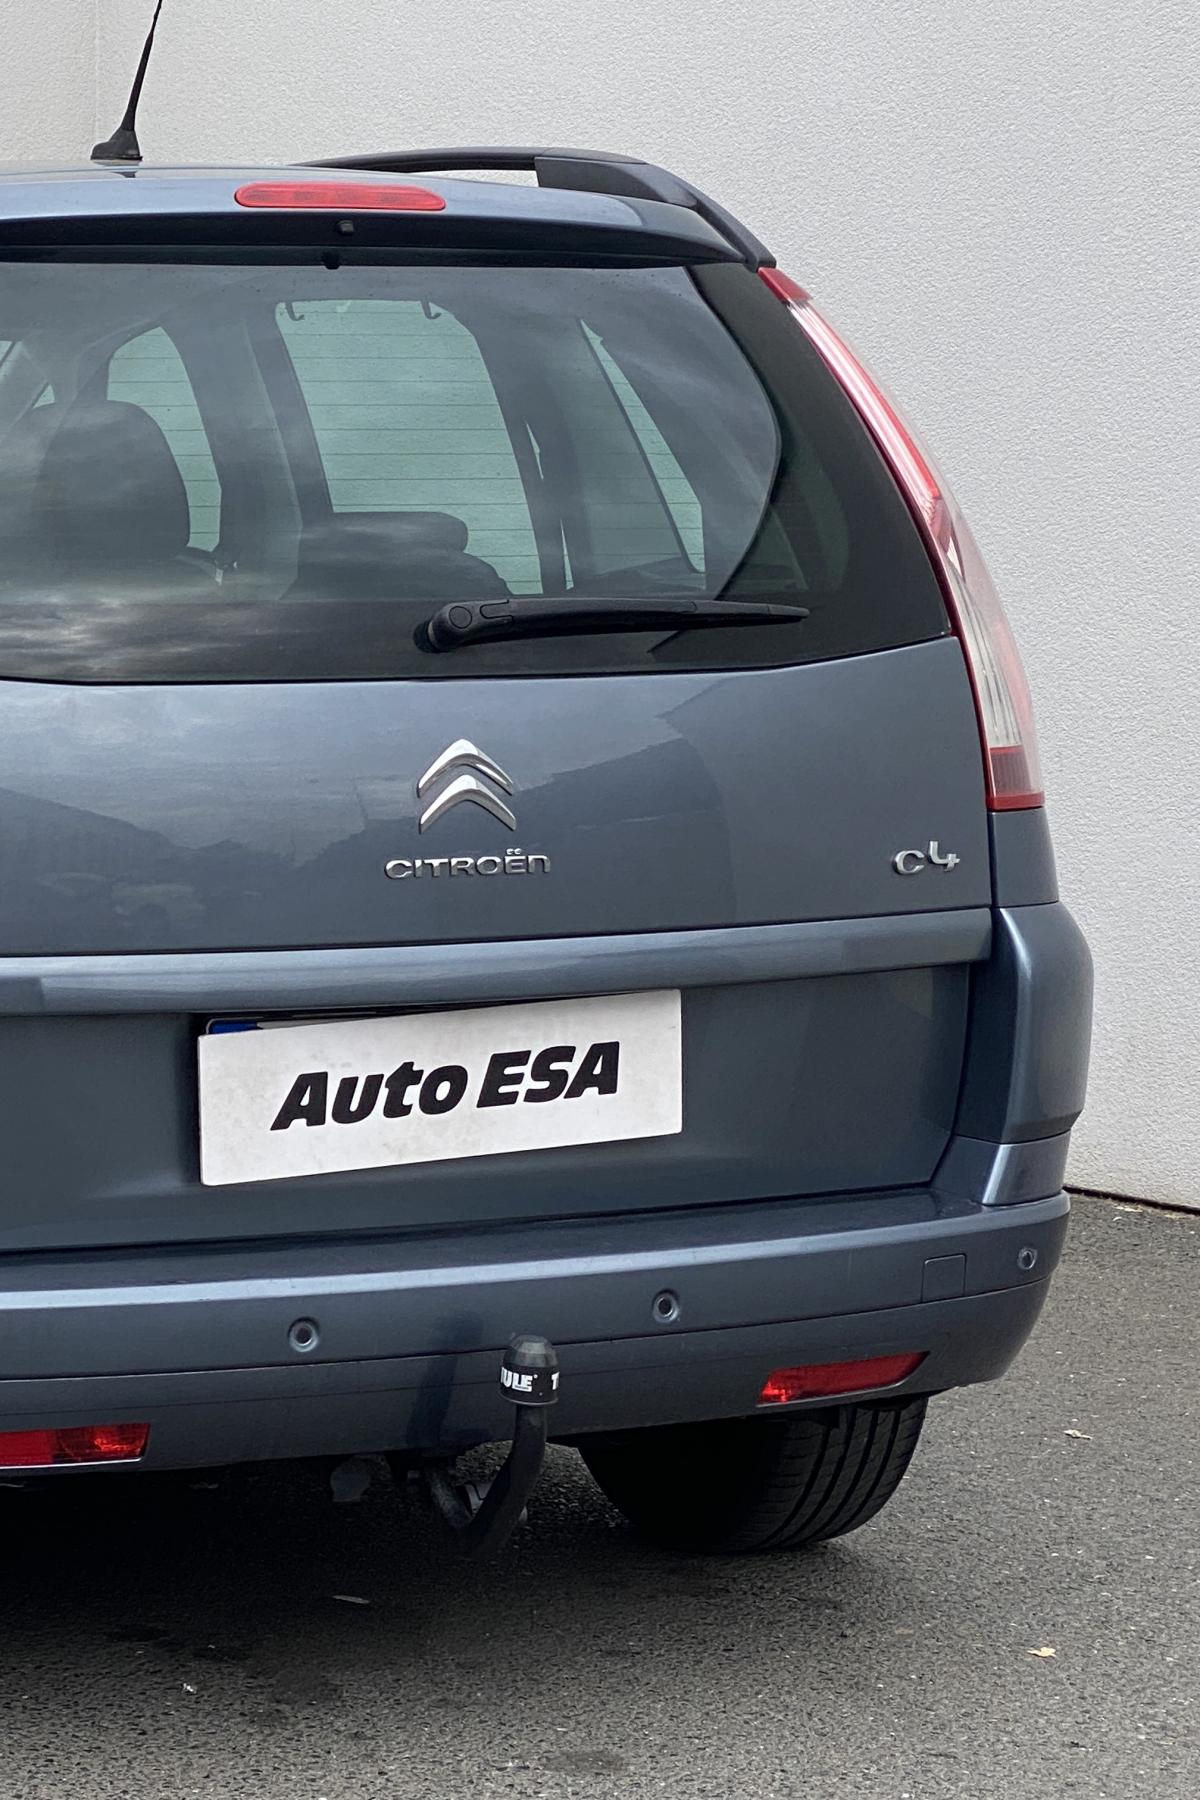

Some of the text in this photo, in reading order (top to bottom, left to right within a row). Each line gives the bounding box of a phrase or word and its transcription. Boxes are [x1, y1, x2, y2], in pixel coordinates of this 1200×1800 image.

[893, 839, 961, 875] C4
[270, 1041, 620, 1131] Auto ESA
